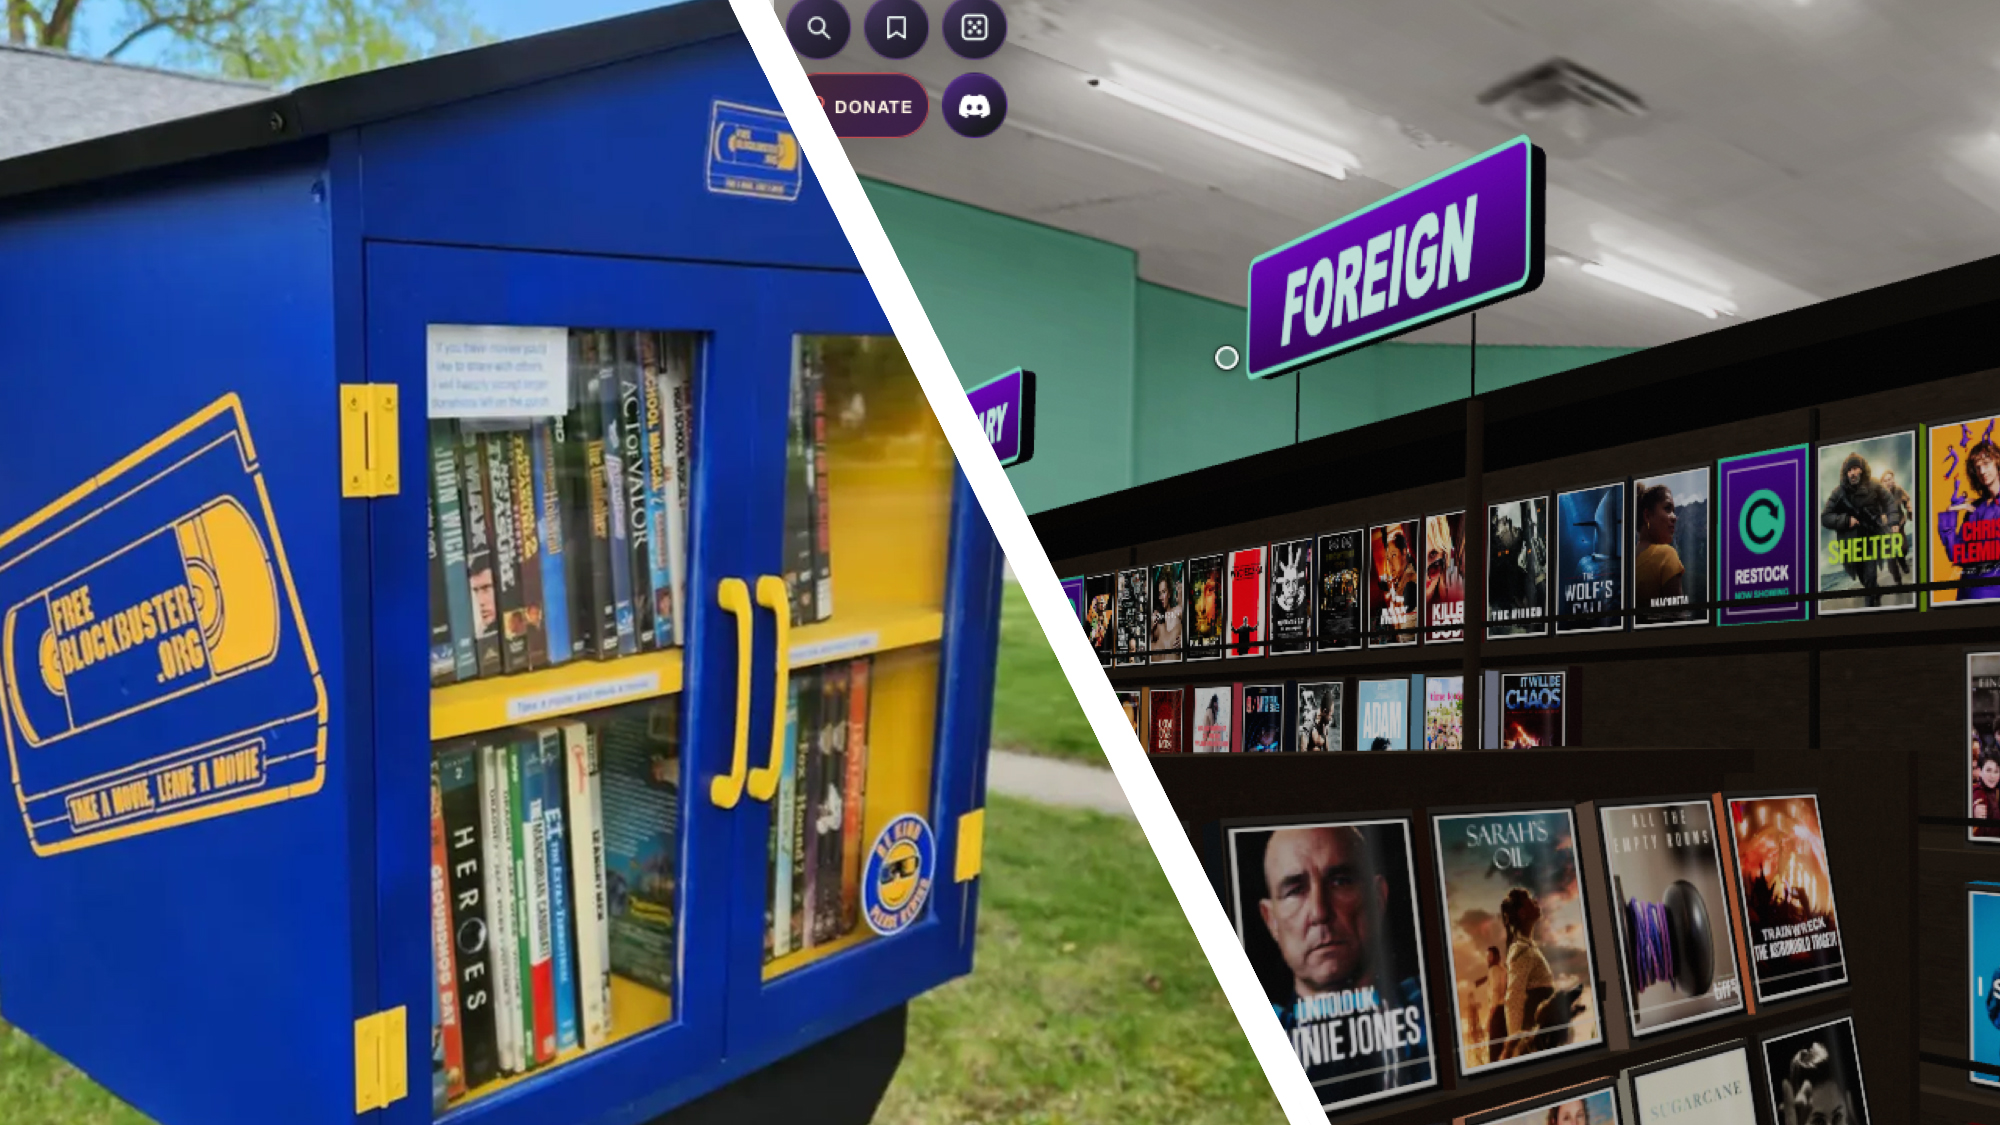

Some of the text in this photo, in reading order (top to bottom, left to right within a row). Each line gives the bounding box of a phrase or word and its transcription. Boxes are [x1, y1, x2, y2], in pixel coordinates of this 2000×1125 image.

[835, 100, 913, 114] DONATE
[1280, 194, 1478, 347] FOREIGN
[645, 366, 662, 429] SCHOOL
[622, 381, 649, 549] ACT OF VALOR
[650, 431, 665, 493] MUSICAL
[435, 447, 466, 566] JOHN WICK
[465, 450, 487, 548] MAX
[588, 440, 609, 538] The Godfather
[488, 440, 515, 591] TREASURE
[1828, 533, 1904, 566] SHELTER
[1565, 580, 1614, 601] WOLF'S
[1734, 565, 1789, 585] RESTOCK
[1734, 587, 1789, 600] NOW SHOWING
[51, 585, 95, 635] FREE
[60, 585, 196, 676] BLOCKBUSTER
[157, 628, 205, 684] .ORG
[1505, 688, 1561, 709] CHAOS
[1520, 676, 1529, 688] IT
[1529, 675, 1549, 687] WILL
[1363, 702, 1402, 738] ADAM
[798, 743, 809, 779] Fox
[69, 792, 100, 826] TAKE
[100, 790, 111, 818] A
[157, 765, 196, 802] LEAVE
[200, 763, 211, 790] A
[213, 746, 260, 787] MOVIE
[894, 820, 922, 842] KIND
[1465, 819, 1549, 848] SARAH'S
[1631, 809, 1687, 828] ALL THE
[1493, 846, 1530, 870] OIL
[1612, 829, 1710, 853] EMPTY ROOMS
[533, 823, 547, 898] MANCHURIAN
[453, 826, 488, 1011] HEROES
[1761, 916, 1827, 942] TRAINWRECK
[431, 864, 456, 1026] GROUNDHOG DAY
[1754, 944, 1769, 962] THE
[1296, 989, 1354, 1023] UNTOLD
[1348, 1006, 1422, 1058] JONES
[1650, 1080, 1742, 1120] SUGARCANE
